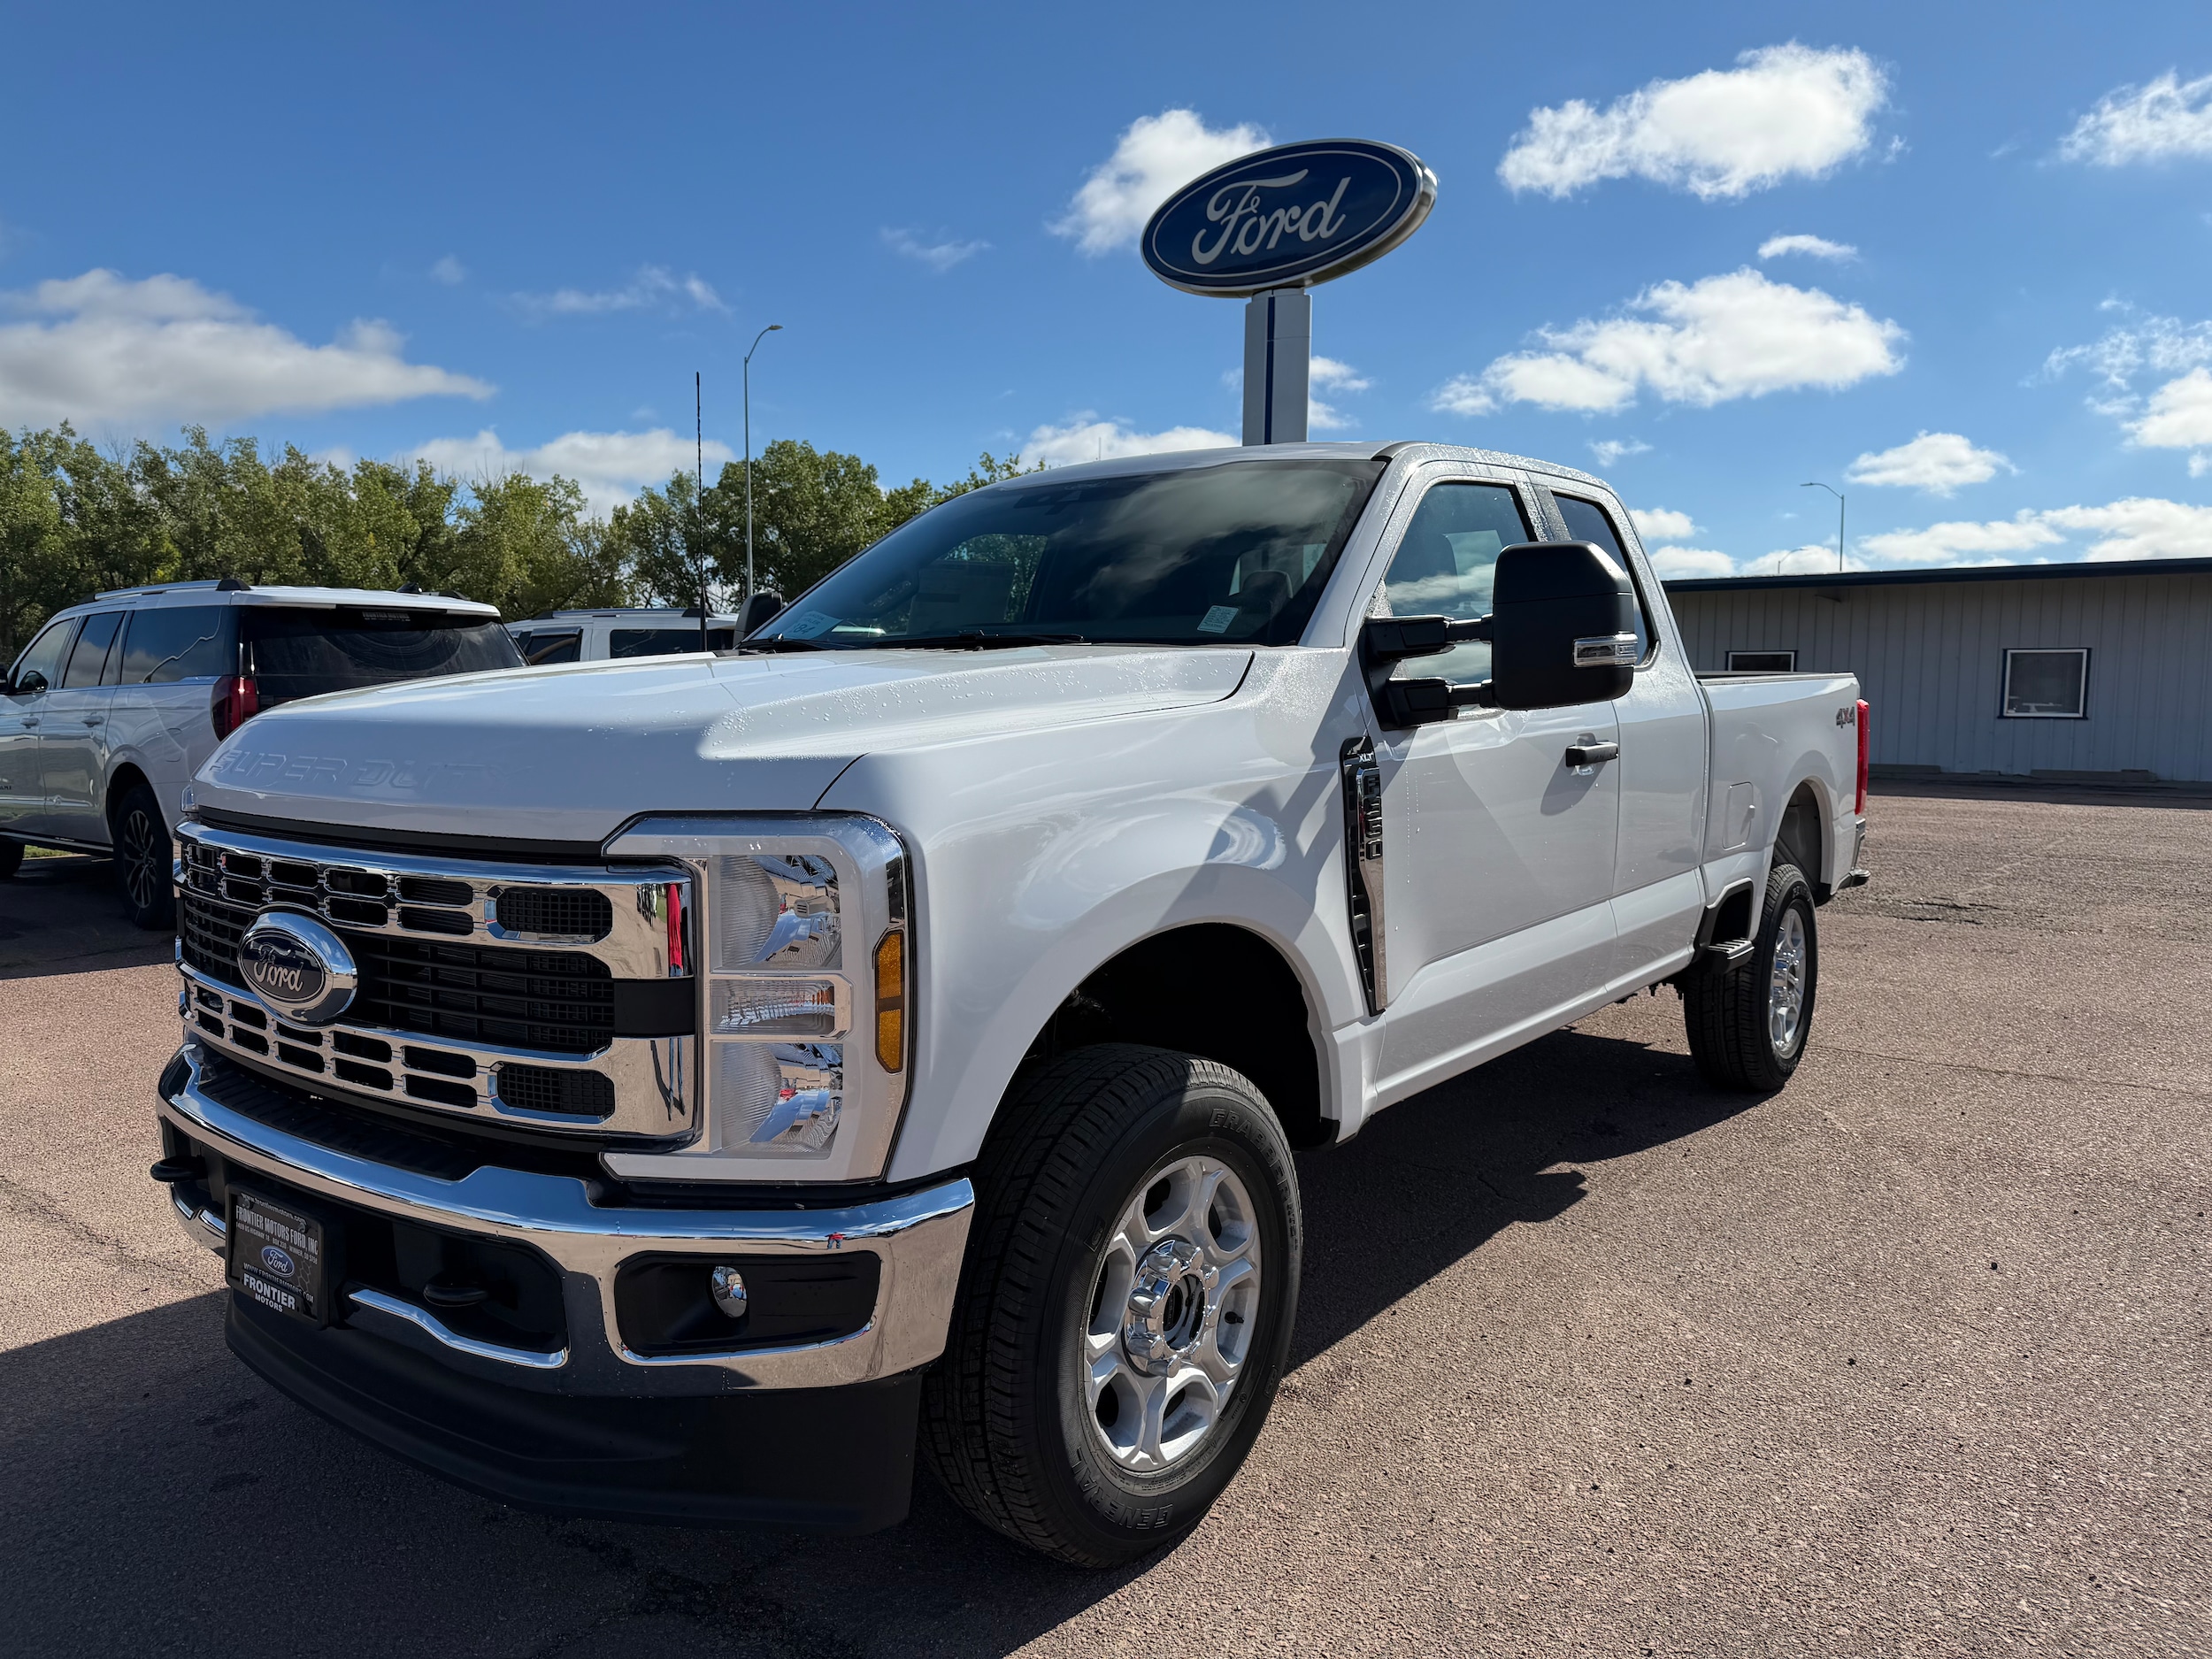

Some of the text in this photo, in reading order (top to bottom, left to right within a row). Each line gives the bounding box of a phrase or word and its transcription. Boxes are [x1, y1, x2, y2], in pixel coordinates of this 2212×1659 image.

[1191, 168, 1352, 265] Ford
[209, 748, 534, 790] SUPER DUTY
[1358, 751, 1374, 763] XLT
[253, 941, 303, 992] Ford
[1209, 1108, 1291, 1202] GRABBER
[236, 1204, 264, 1231] FRONTIER
[264, 1217, 290, 1241] MOTORS
[267, 1249, 288, 1272] Ford
[243, 1263, 314, 1303] WWWFRONTIERMOTORSCOM
[243, 1273, 296, 1310] FRONTIER
[255, 1294, 283, 1313] MOTORS
[1071, 1446, 1173, 1529] GENERAL
